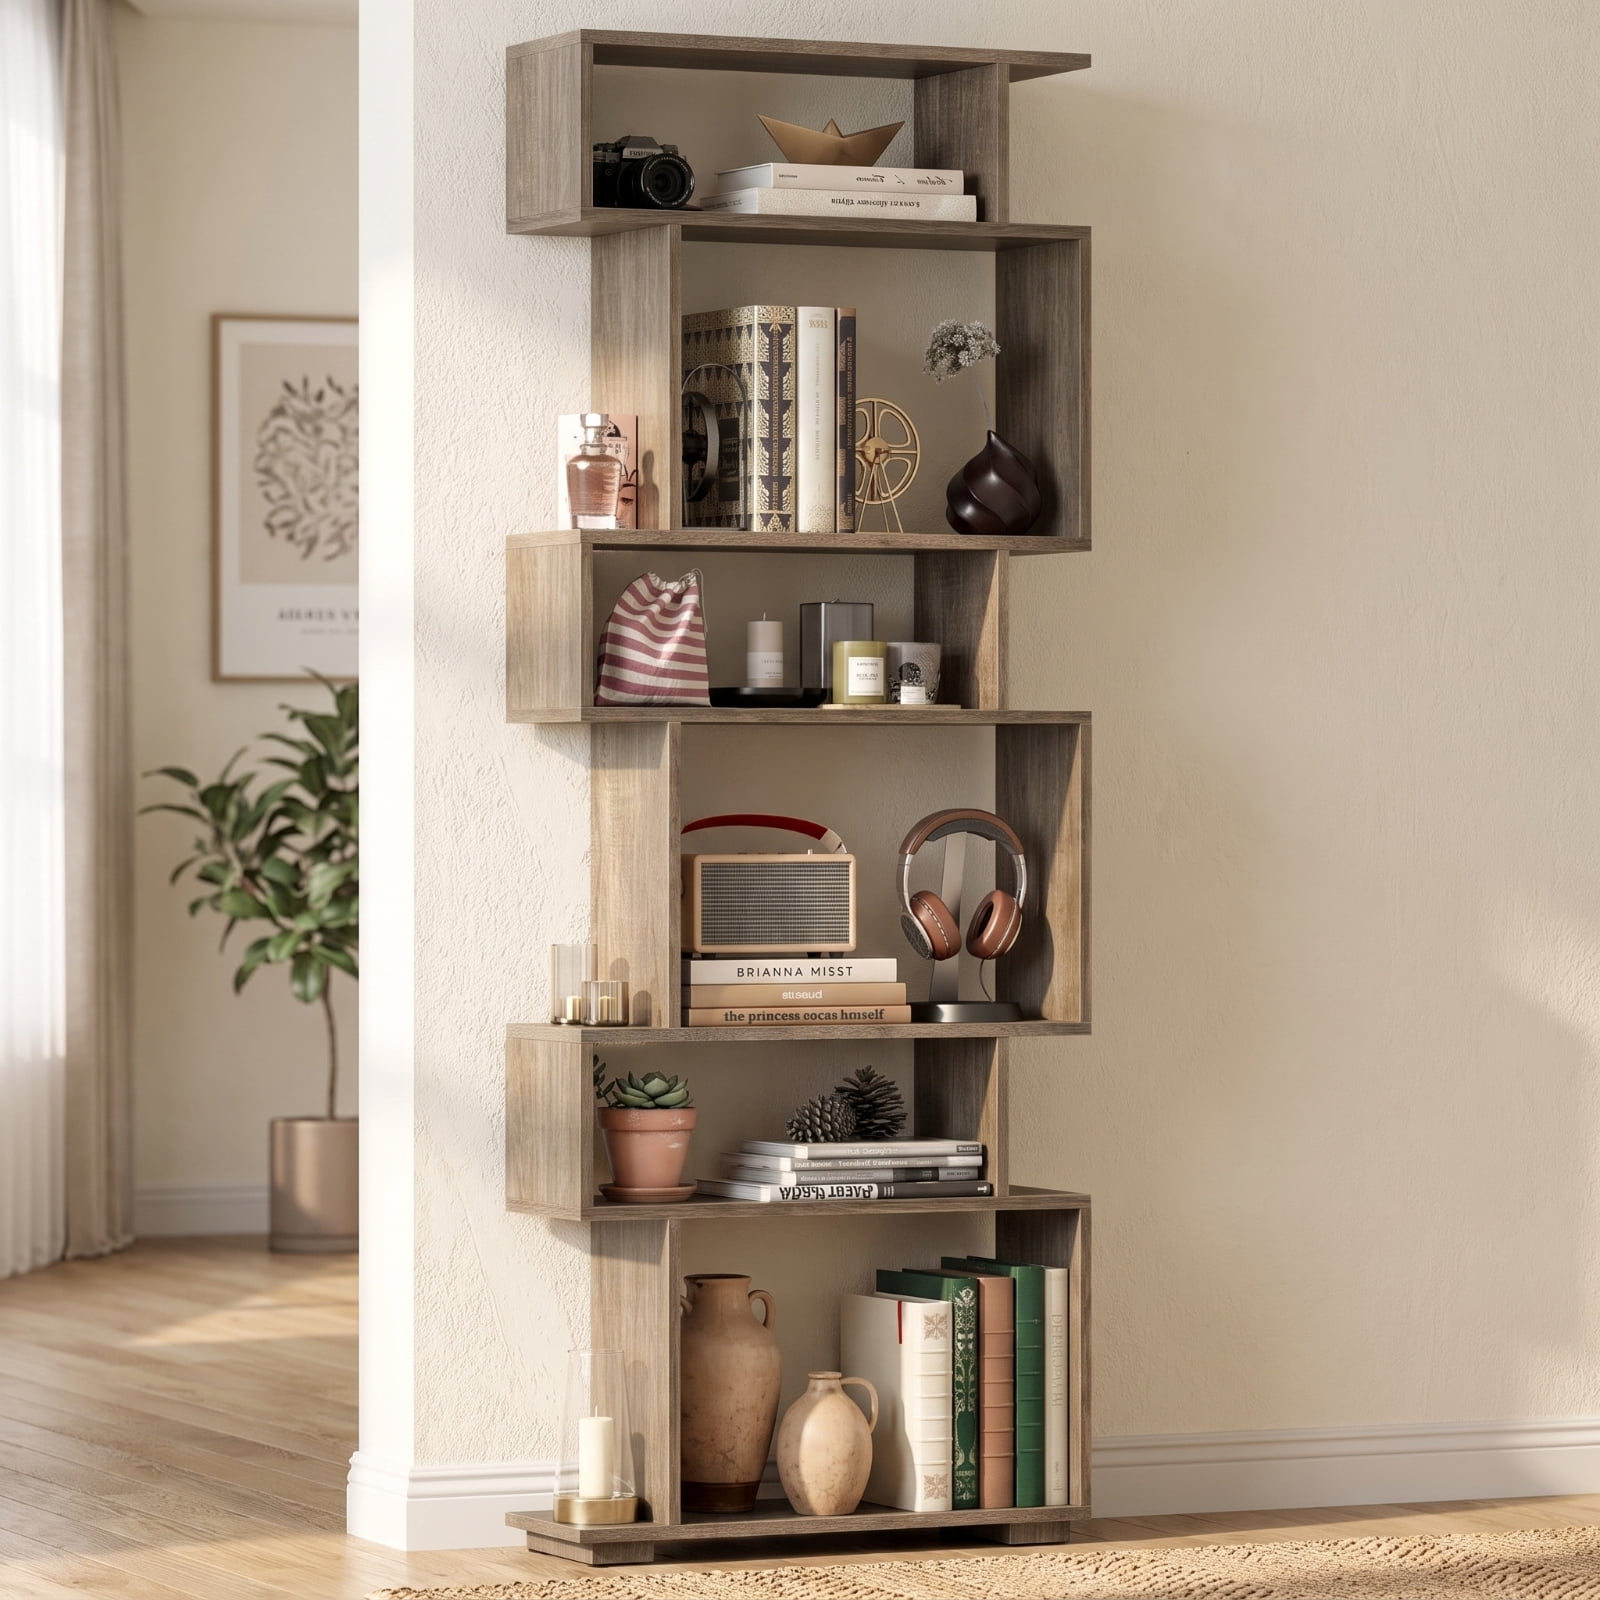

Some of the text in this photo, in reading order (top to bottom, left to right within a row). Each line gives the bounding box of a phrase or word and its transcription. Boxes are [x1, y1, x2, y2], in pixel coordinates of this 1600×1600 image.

[737, 966, 853, 978] BRIANNA MISST
[724, 1010, 745, 1022] the
[748, 1010, 800, 1025] princess
